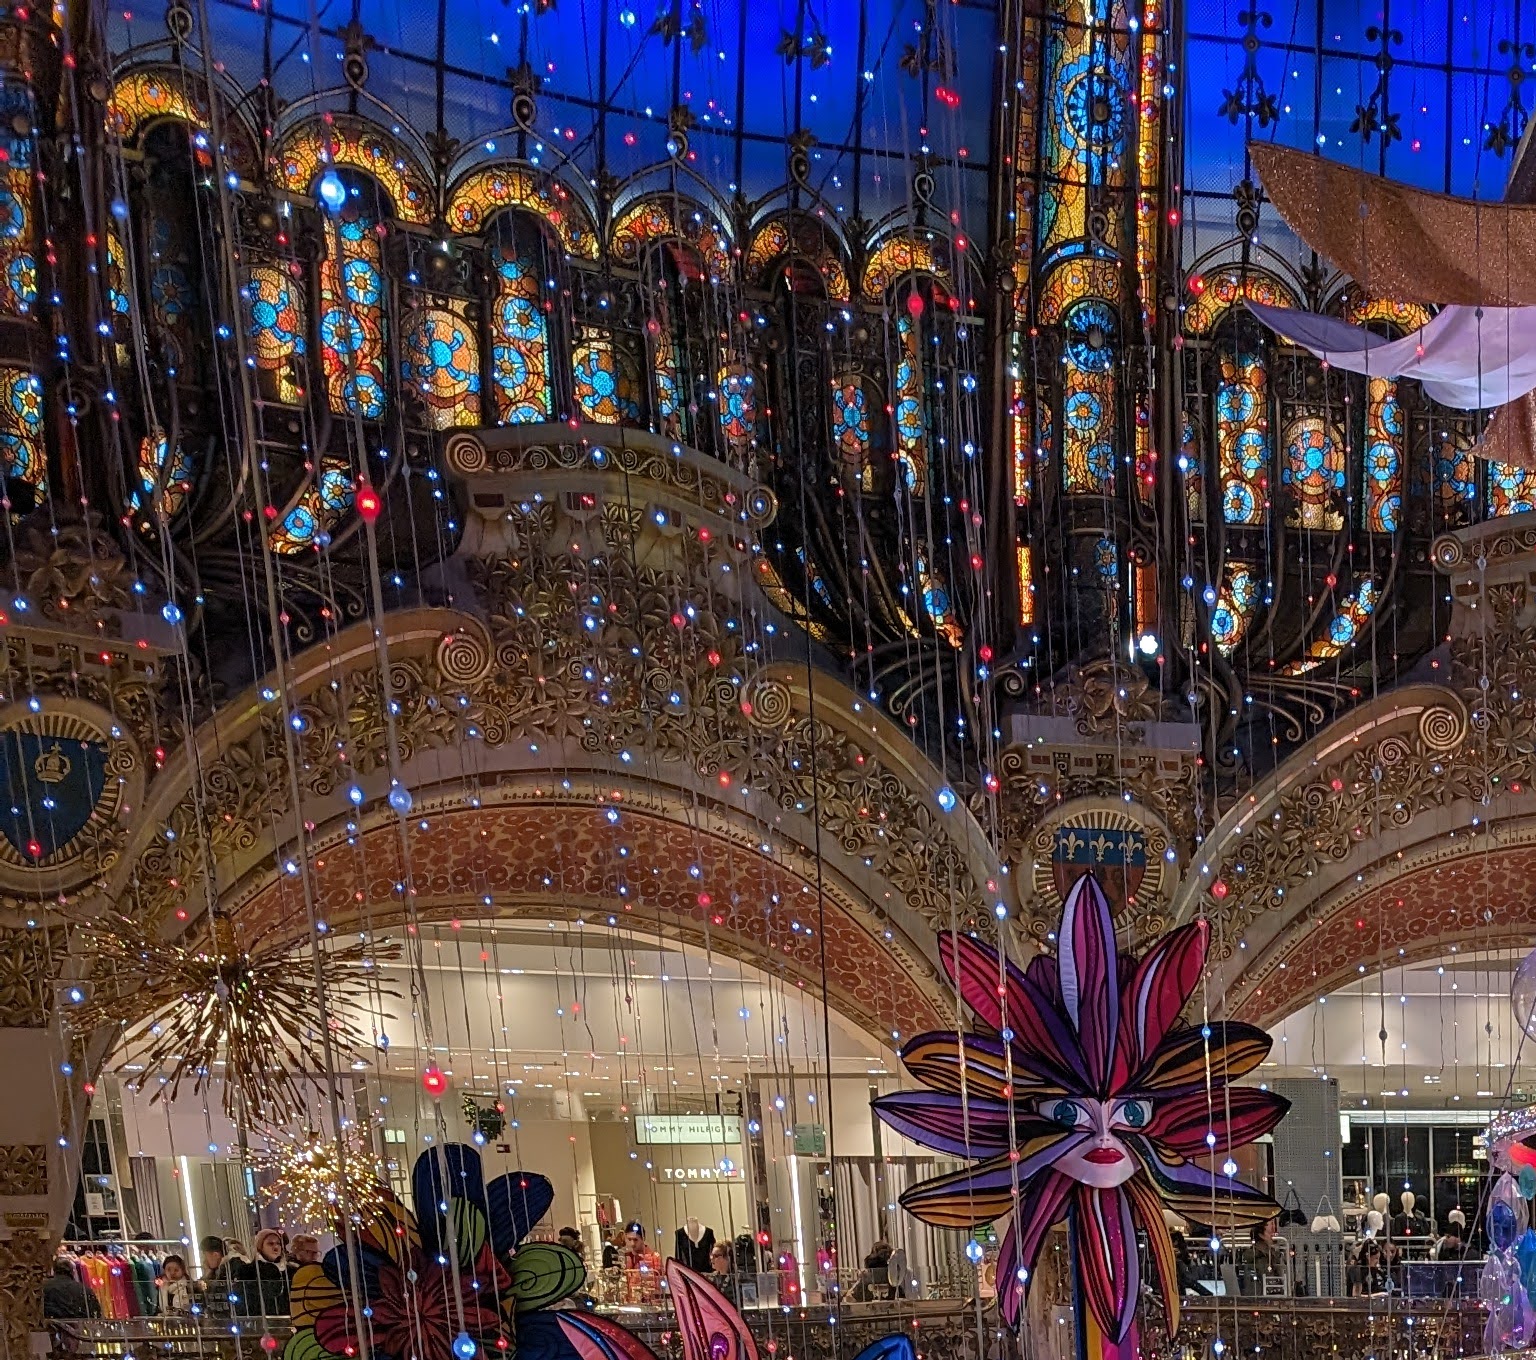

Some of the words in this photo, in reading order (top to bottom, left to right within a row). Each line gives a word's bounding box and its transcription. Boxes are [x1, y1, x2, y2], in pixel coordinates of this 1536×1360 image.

[645, 1125, 682, 1133] OMMY
[689, 1125, 733, 1133] HILFIGR
[664, 1168, 720, 1179] TOMMY
